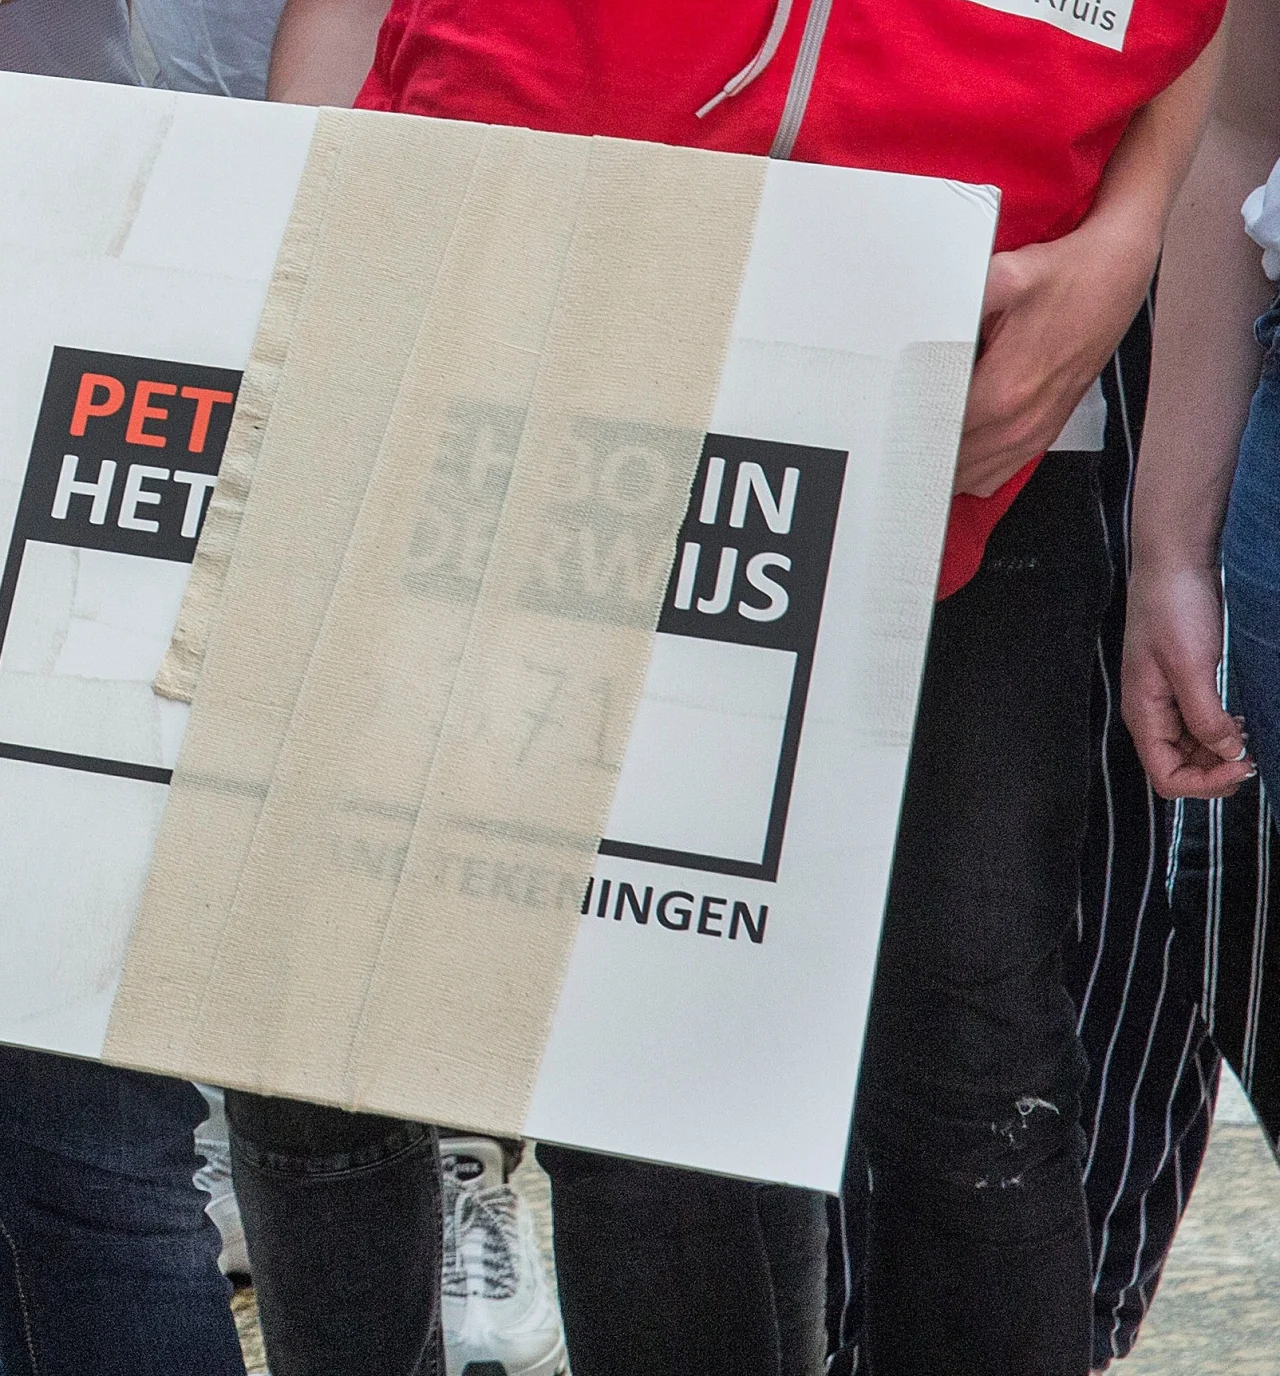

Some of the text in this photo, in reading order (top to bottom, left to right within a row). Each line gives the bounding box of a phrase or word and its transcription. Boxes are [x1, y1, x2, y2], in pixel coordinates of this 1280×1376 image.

[50, 454, 219, 539] HET
[70, 372, 233, 453] PET
[698, 456, 800, 534] IN
